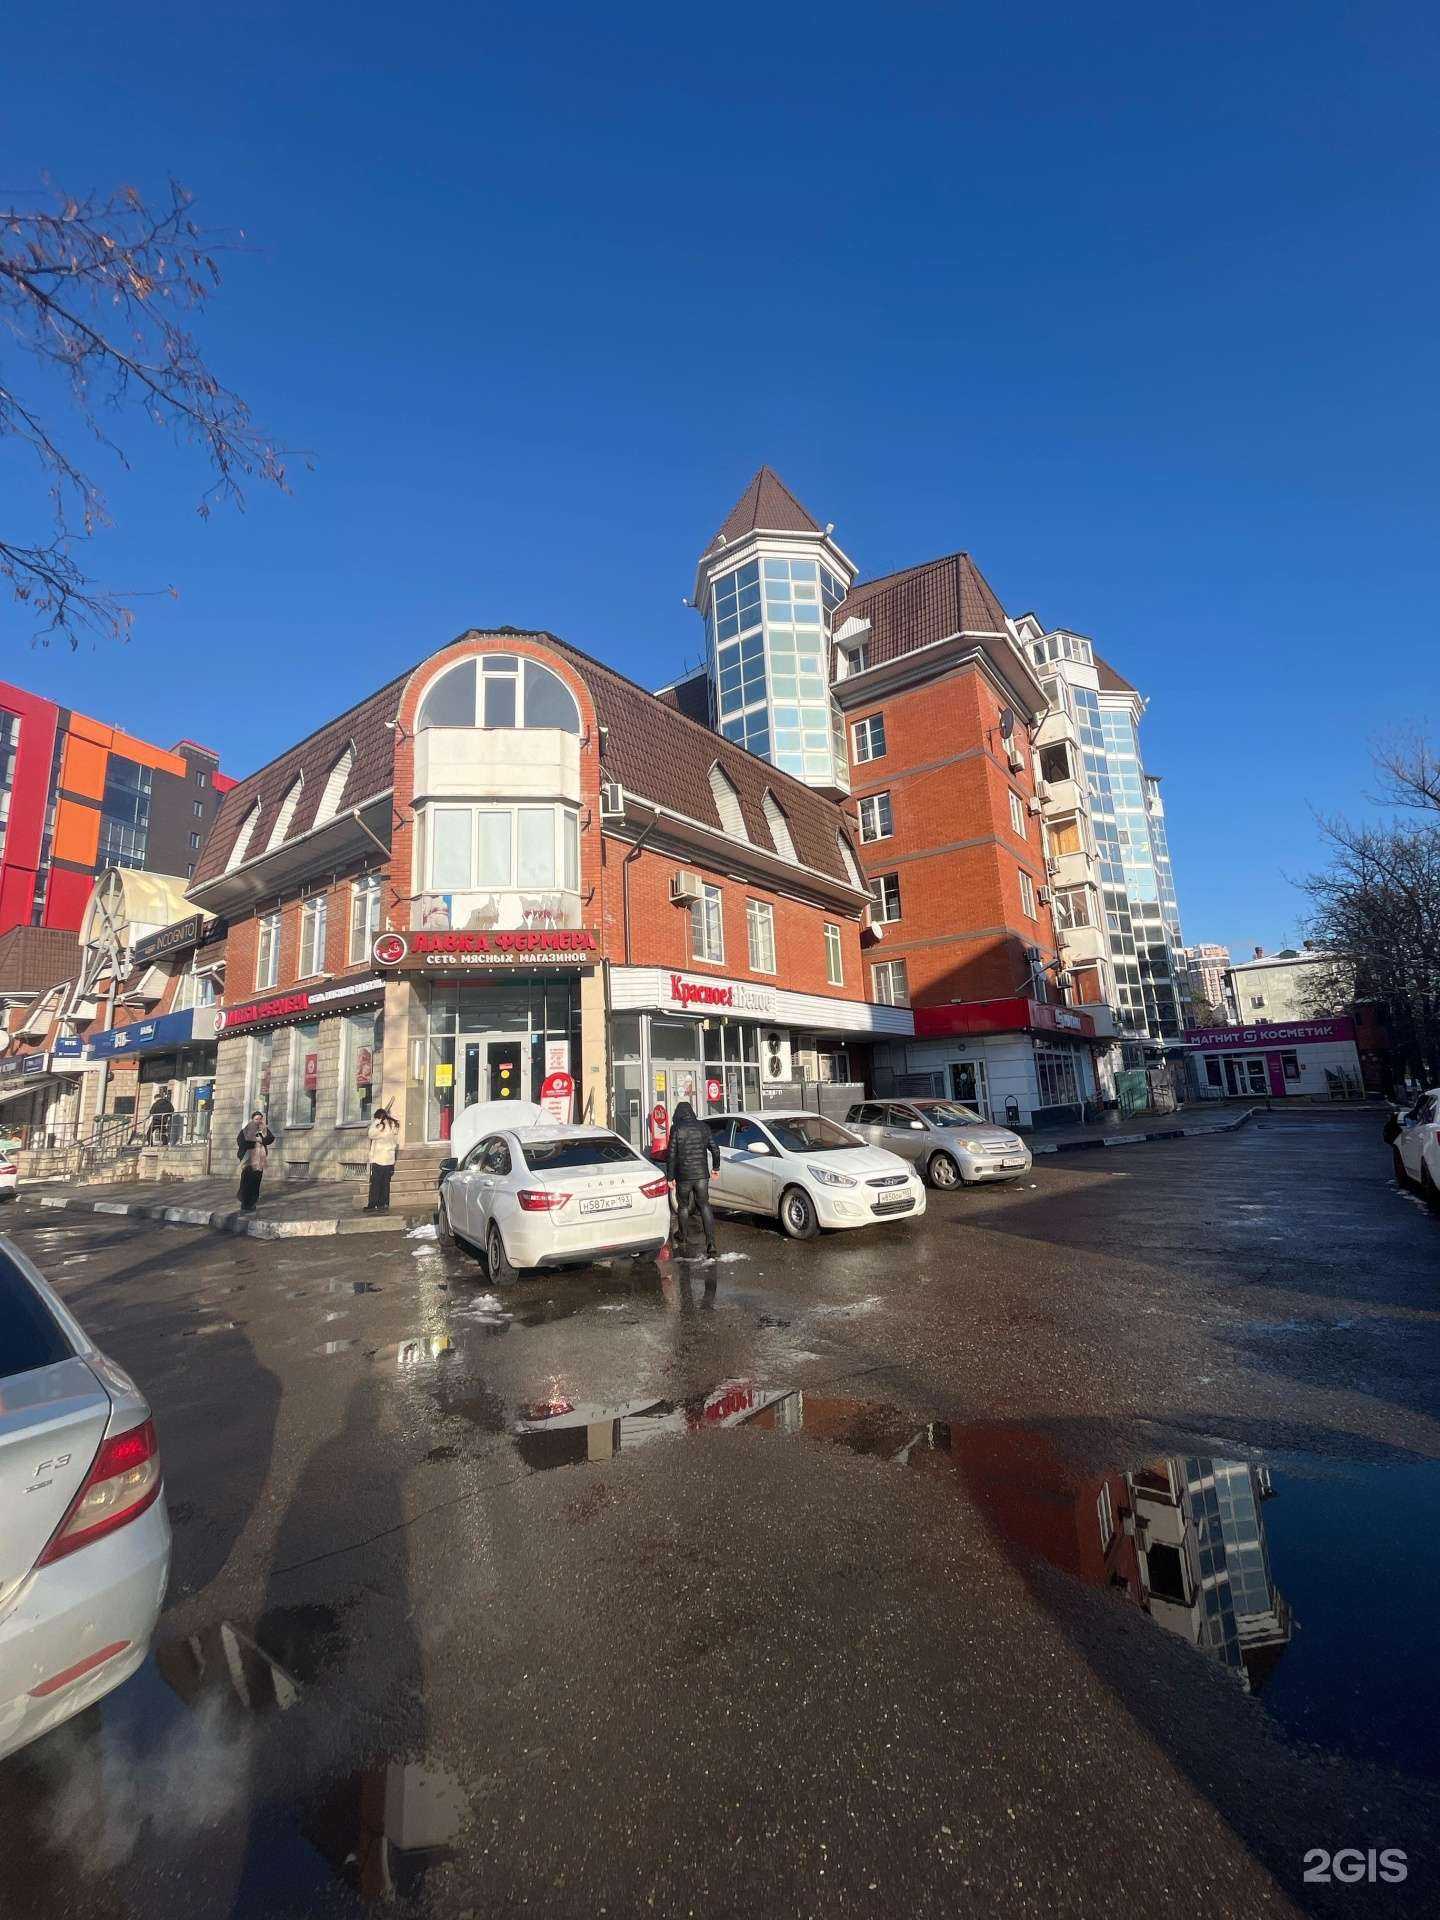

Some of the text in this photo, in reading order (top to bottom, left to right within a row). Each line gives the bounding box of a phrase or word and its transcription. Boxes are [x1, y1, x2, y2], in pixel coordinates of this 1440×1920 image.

[411, 931, 597, 953] ЛАВКА ФЕРМЕРА
[426, 953, 587, 964] СЕТЬ МЯСНЫХ МАГАЗИНОВ
[1190, 1026, 1334, 1045] МАГНИТ КОСМЕТИК
[34, 1453, 72, 1477] F3
